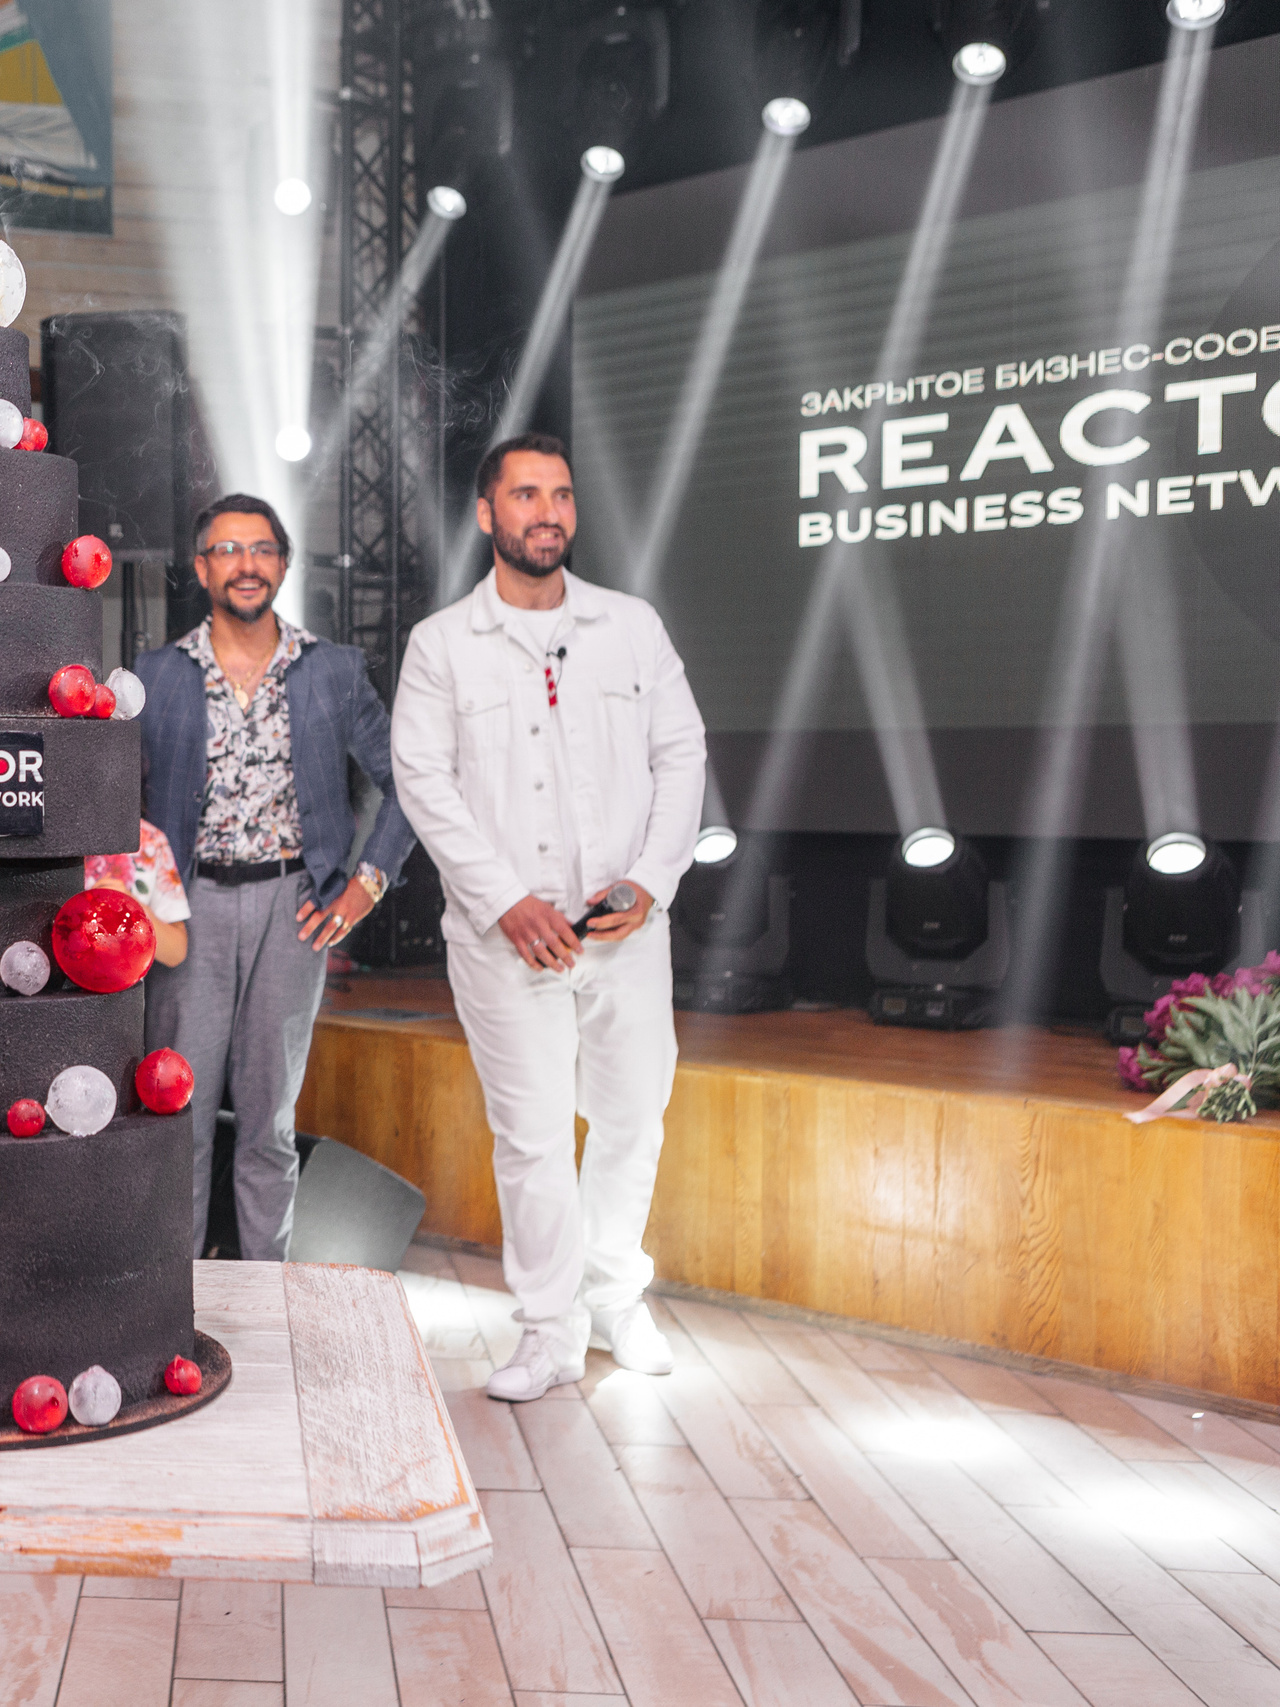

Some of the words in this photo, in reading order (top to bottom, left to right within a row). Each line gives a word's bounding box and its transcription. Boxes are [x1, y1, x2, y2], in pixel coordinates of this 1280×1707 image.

[801, 367, 985, 417] ЗАКРЫТОЕ
[995, 325, 1280, 391] БИЗНЕС-СООБ
[799, 371, 1280, 498] REACT
[799, 487, 1084, 548] BUSINESS
